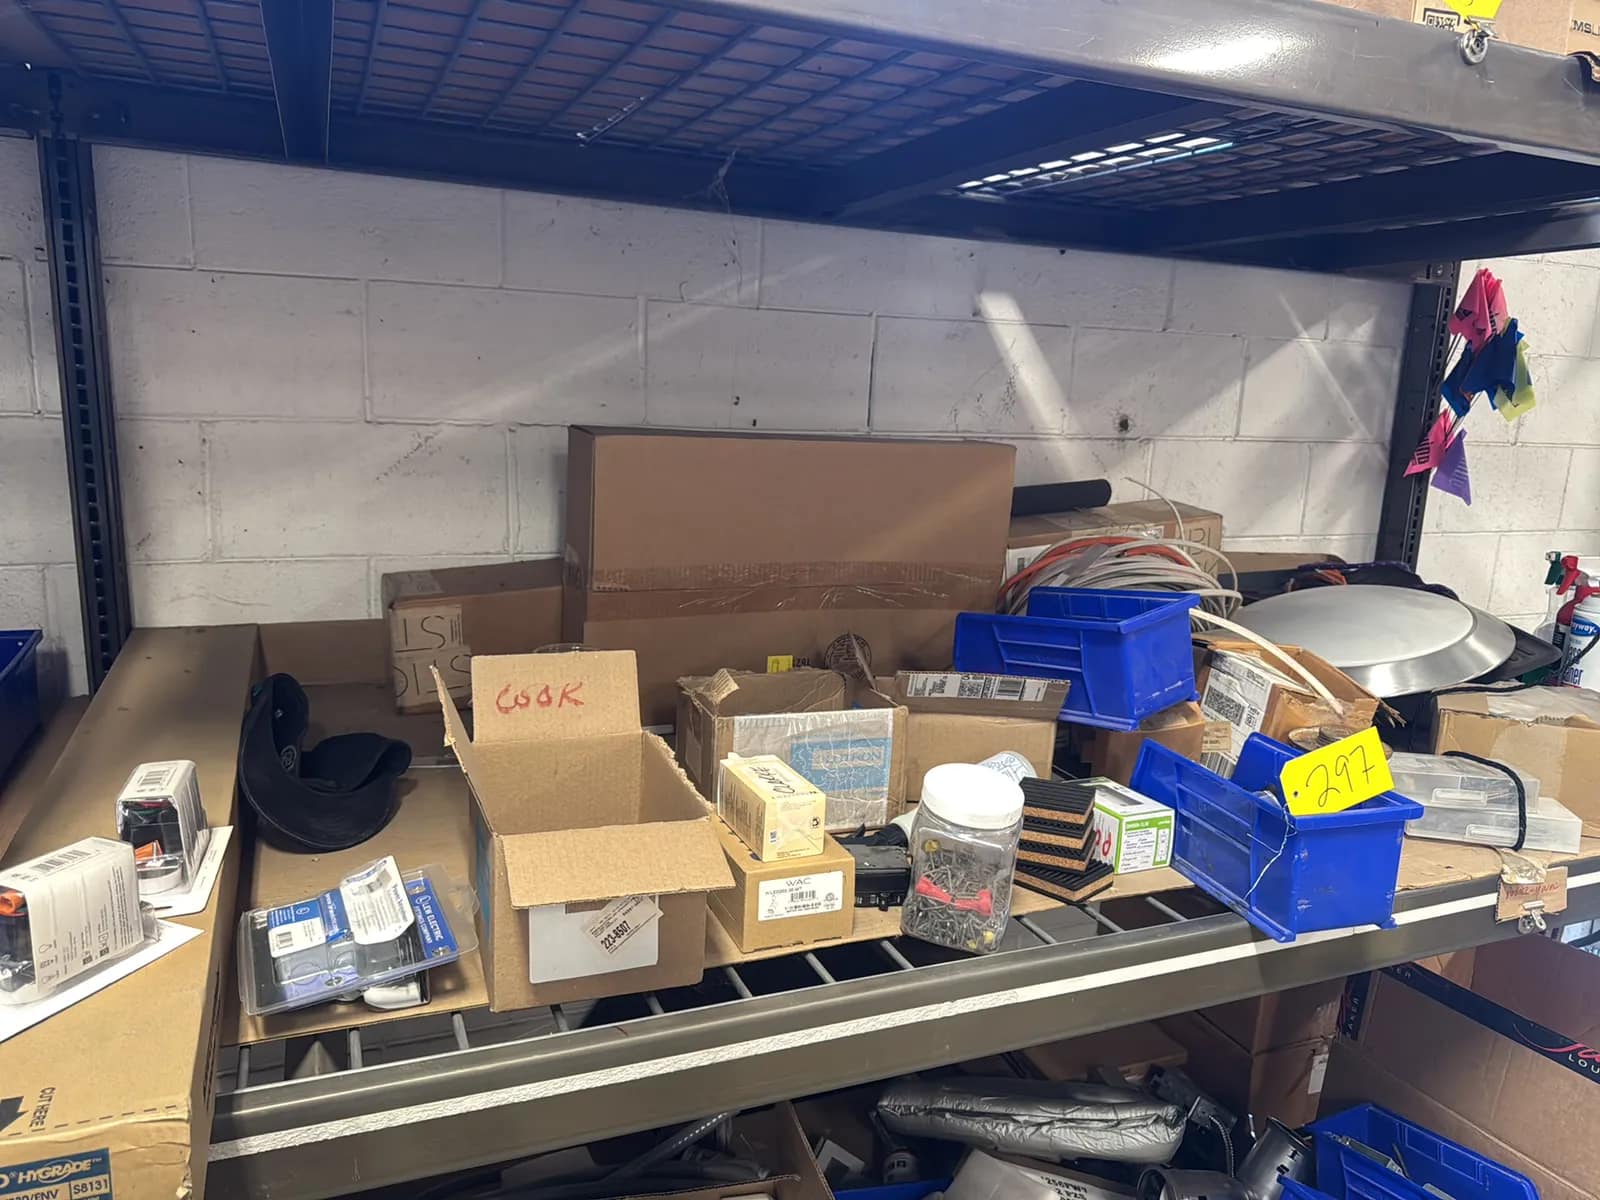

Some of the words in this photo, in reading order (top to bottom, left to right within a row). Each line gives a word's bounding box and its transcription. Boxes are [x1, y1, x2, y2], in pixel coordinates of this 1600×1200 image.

[1305, 745, 1376, 808] 297
[786, 877, 812, 886] WAC
[600, 920, 631, 950] 223-8507
[73, 1178, 108, 1194] S8131
